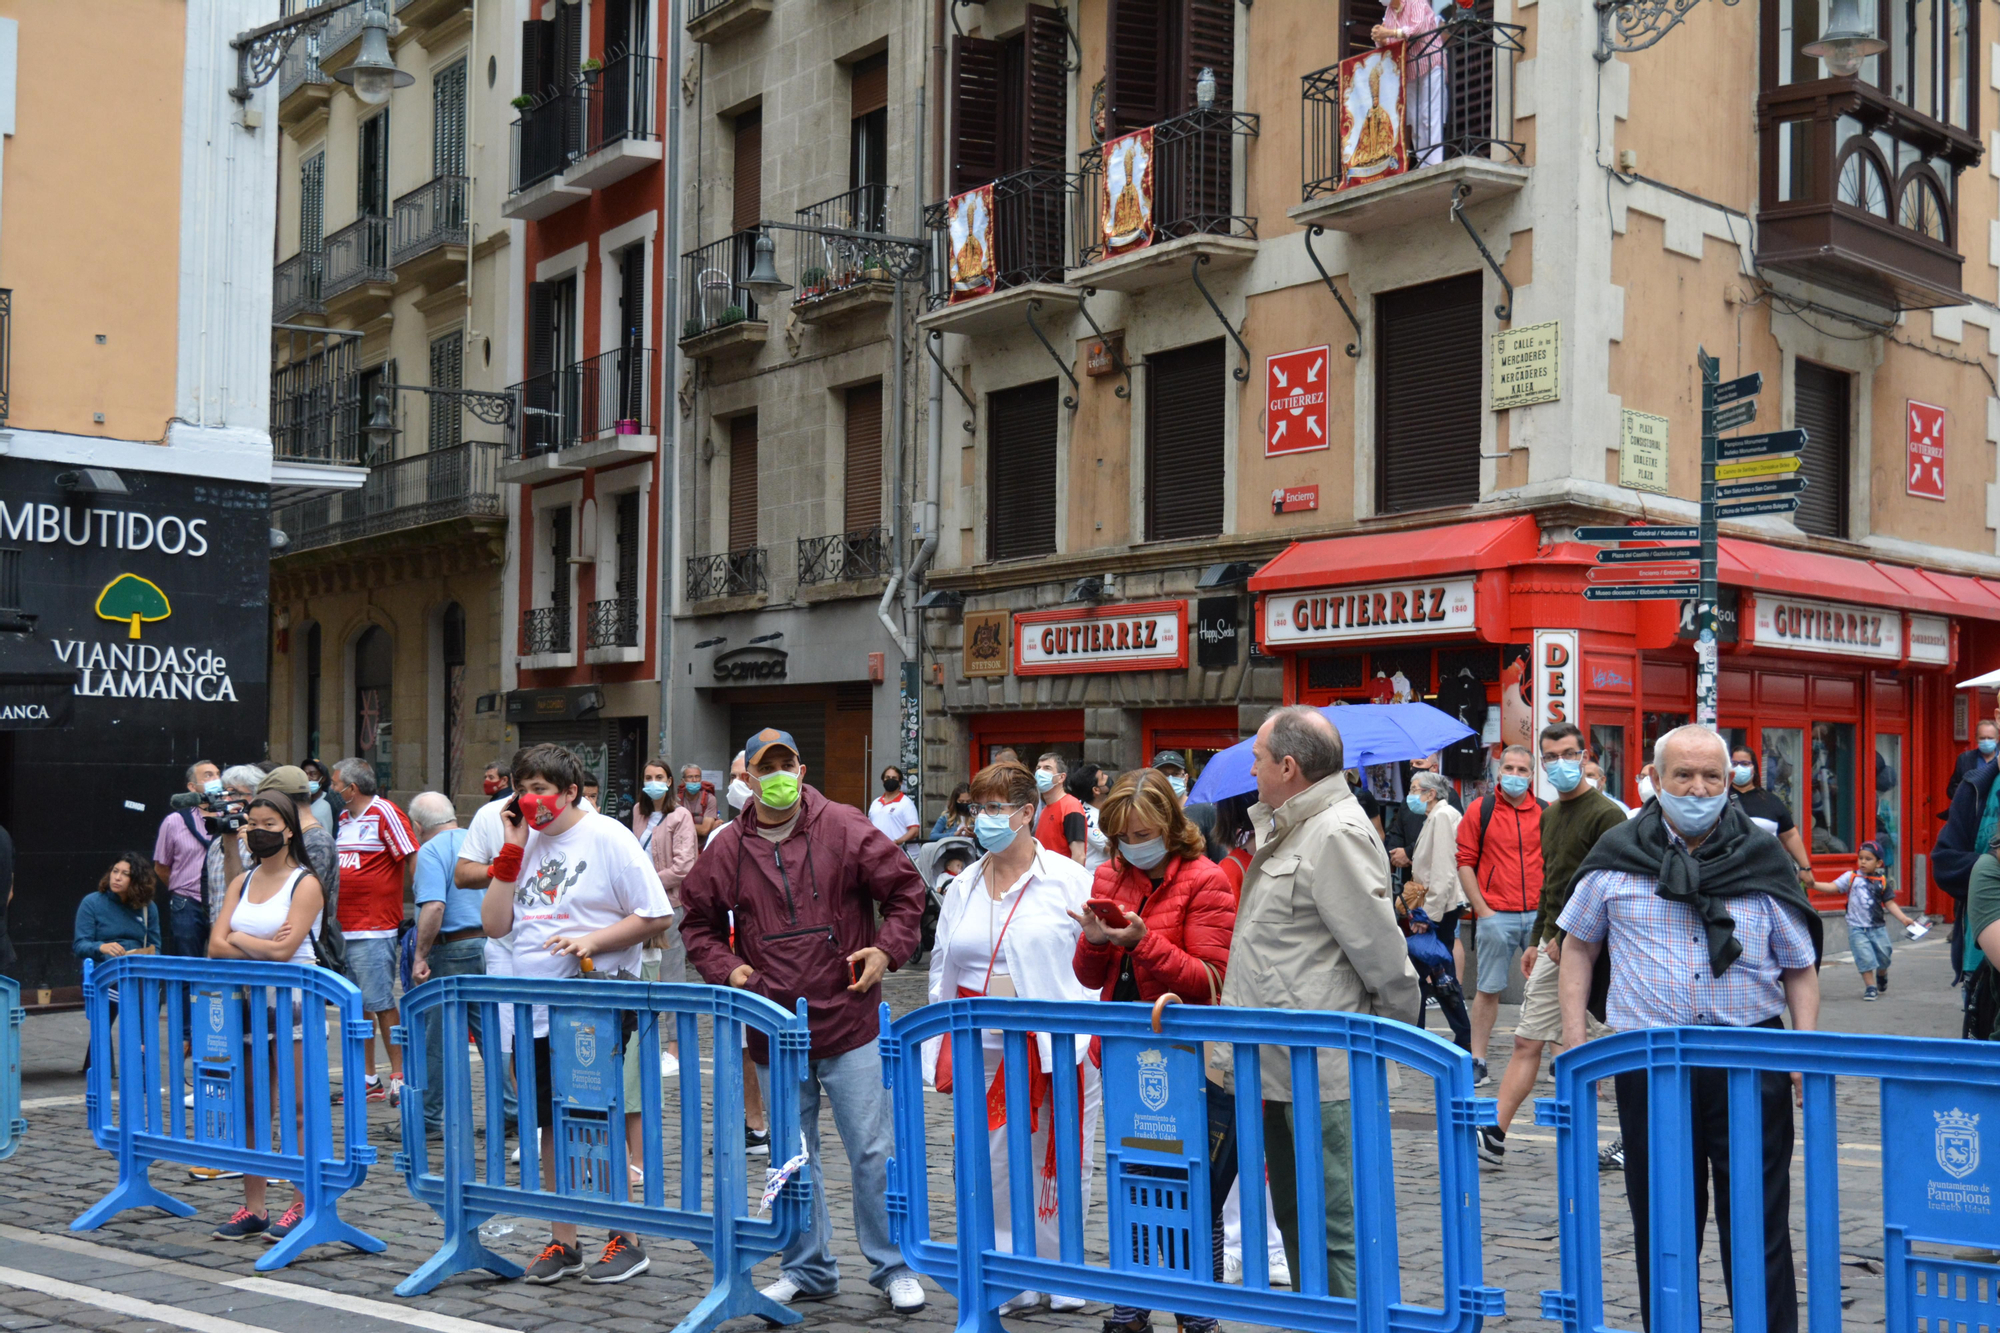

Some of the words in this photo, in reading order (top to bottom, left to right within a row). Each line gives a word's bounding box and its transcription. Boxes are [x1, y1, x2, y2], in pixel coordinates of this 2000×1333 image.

[1514, 338, 1534, 350] CALLE
[1501, 350, 1547, 367] MERCADERES
[1500, 367, 1548, 384] MERCADERES
[1511, 382, 1534, 394] KALEA
[1270, 392, 1324, 411] GUTIERREZ
[1639, 423, 1653, 434] PLAZA
[1630, 436, 1661, 450] CONSISTORIAL
[1910, 442, 1943, 458] GUTIERREZ
[1638, 468, 1653, 480] PLAZA
[1286, 492, 1315, 502] Encierro
[0, 502, 208, 556] MBUTIDOS
[1274, 619, 1287, 627] 1840
[1292, 586, 1446, 632] GUTIERREZ
[1452, 604, 1467, 613] 1840
[1718, 610, 1735, 622] GOL
[1199, 619, 1218, 644] Happy
[1217, 619, 1235, 640] Socks
[1774, 604, 1882, 647] GUTIERREZ
[1041, 620, 1157, 656] GUTIERREZ
[1911, 633, 1946, 647] OMBRERERÍA
[714, 646, 788, 680] Samoa
[972, 660, 1001, 670] STETSON
[74, 668, 239, 702] LAMANCA
[0, 705, 50, 720] ANCA
[338, 852, 361, 869] BVA
[572, 1073, 601, 1085] Pamplona
[1134, 1113, 1168, 1122] Ayuntamiento
[1169, 1115, 1176, 1123] de
[1134, 1120, 1176, 1134] Pamplona
[1134, 1131, 1157, 1139] Iruñeko
[1927, 1180, 1978, 1192] Ayuntamiento
[1980, 1184, 1990, 1193] de
[1927, 1187, 1991, 1205] Pamplona
[1928, 1201, 1961, 1212] Iruñeko
[1964, 1204, 1991, 1215] Udala
